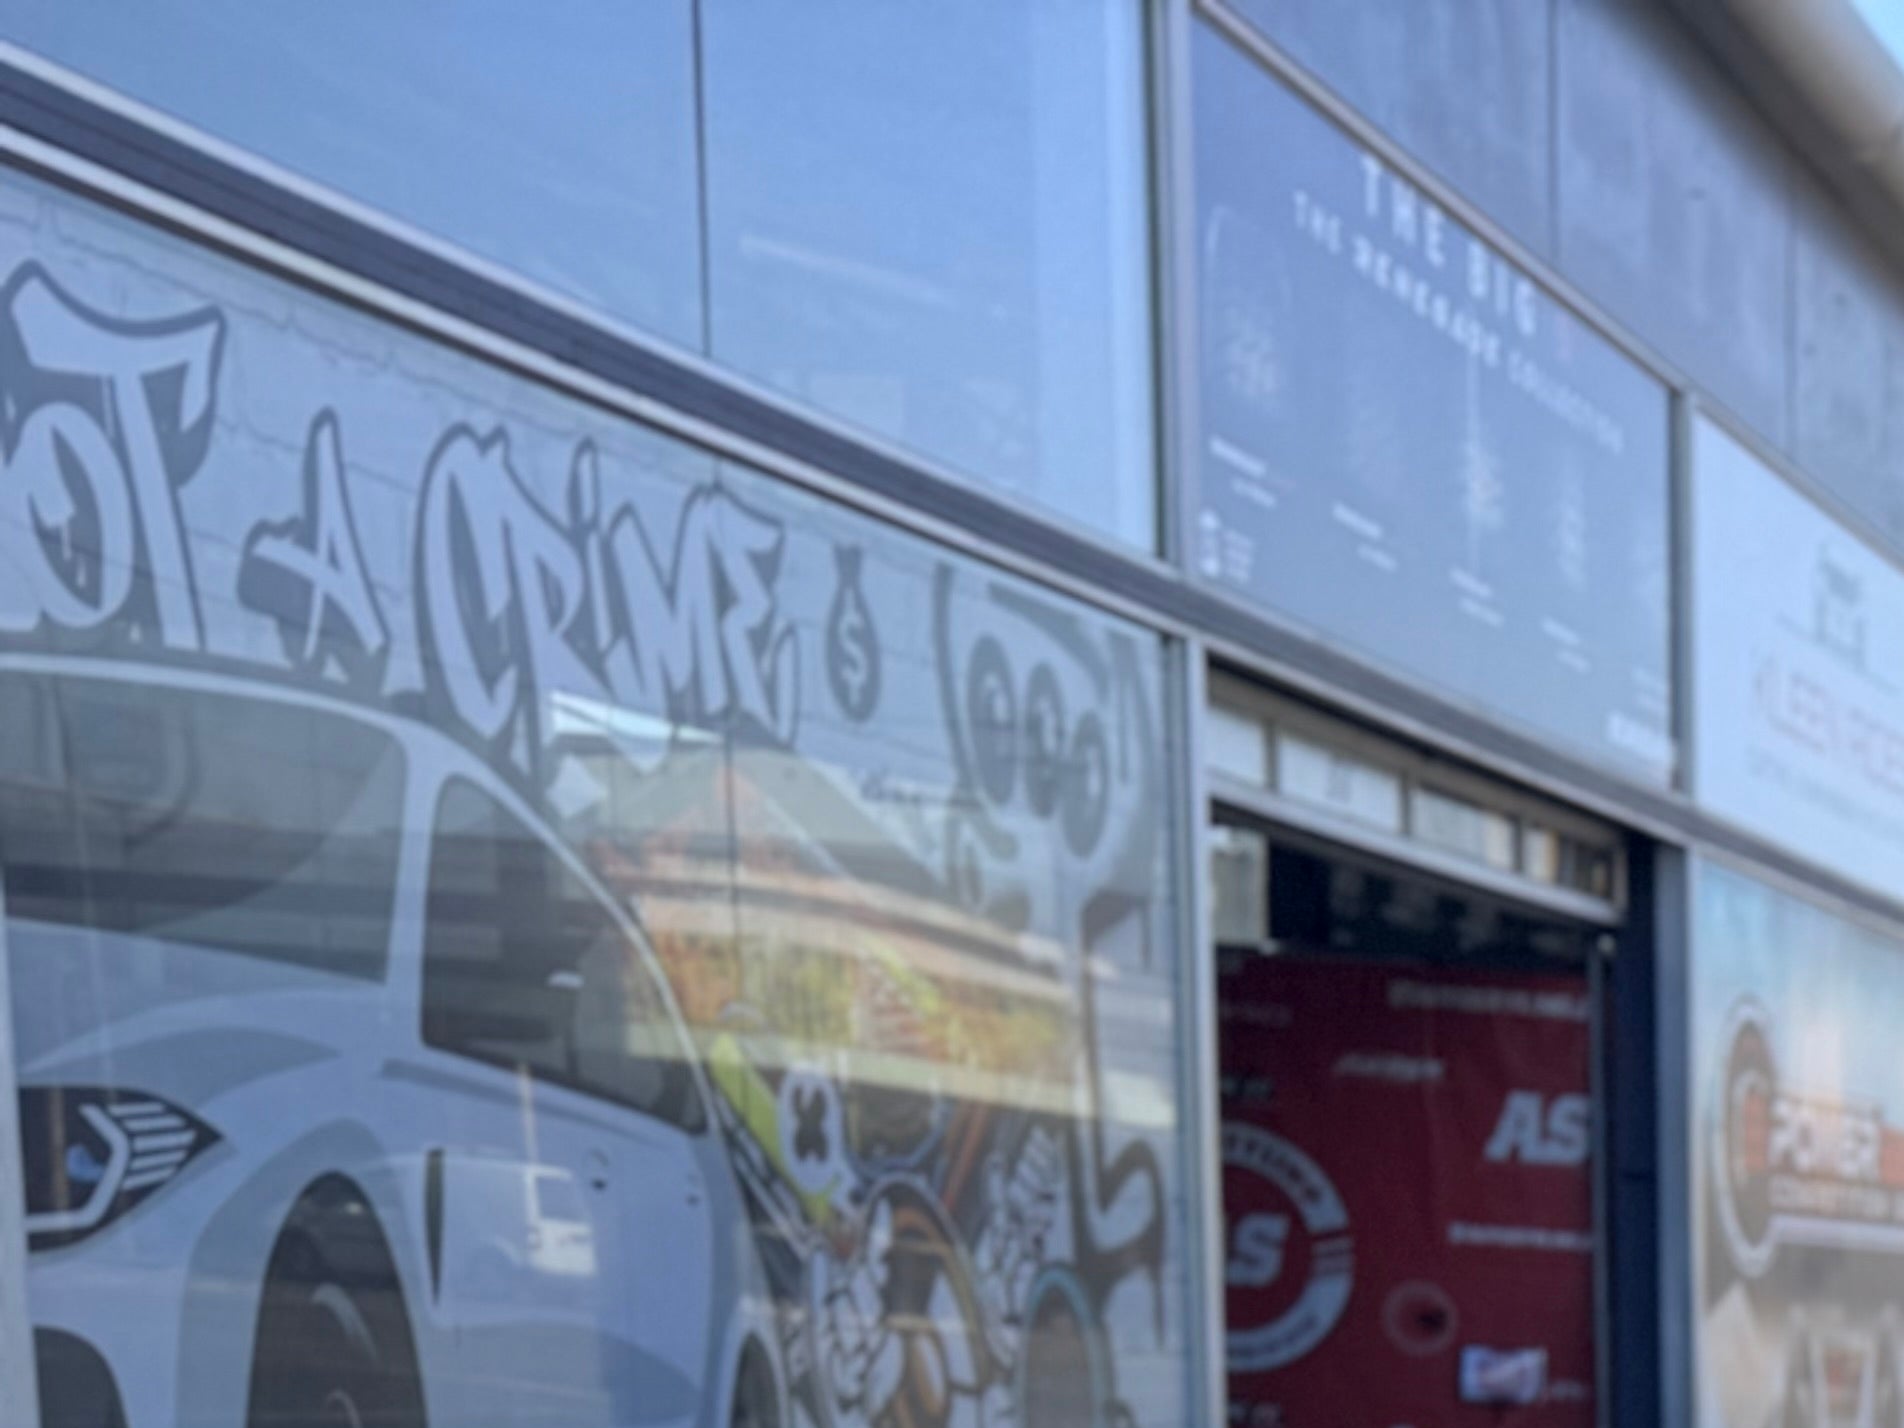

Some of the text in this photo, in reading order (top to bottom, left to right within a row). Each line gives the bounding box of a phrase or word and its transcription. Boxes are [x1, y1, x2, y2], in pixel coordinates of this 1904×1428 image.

[1294, 187, 1343, 256] THE
[1361, 153, 1446, 268] THE
[0, 258, 226, 652] OT
